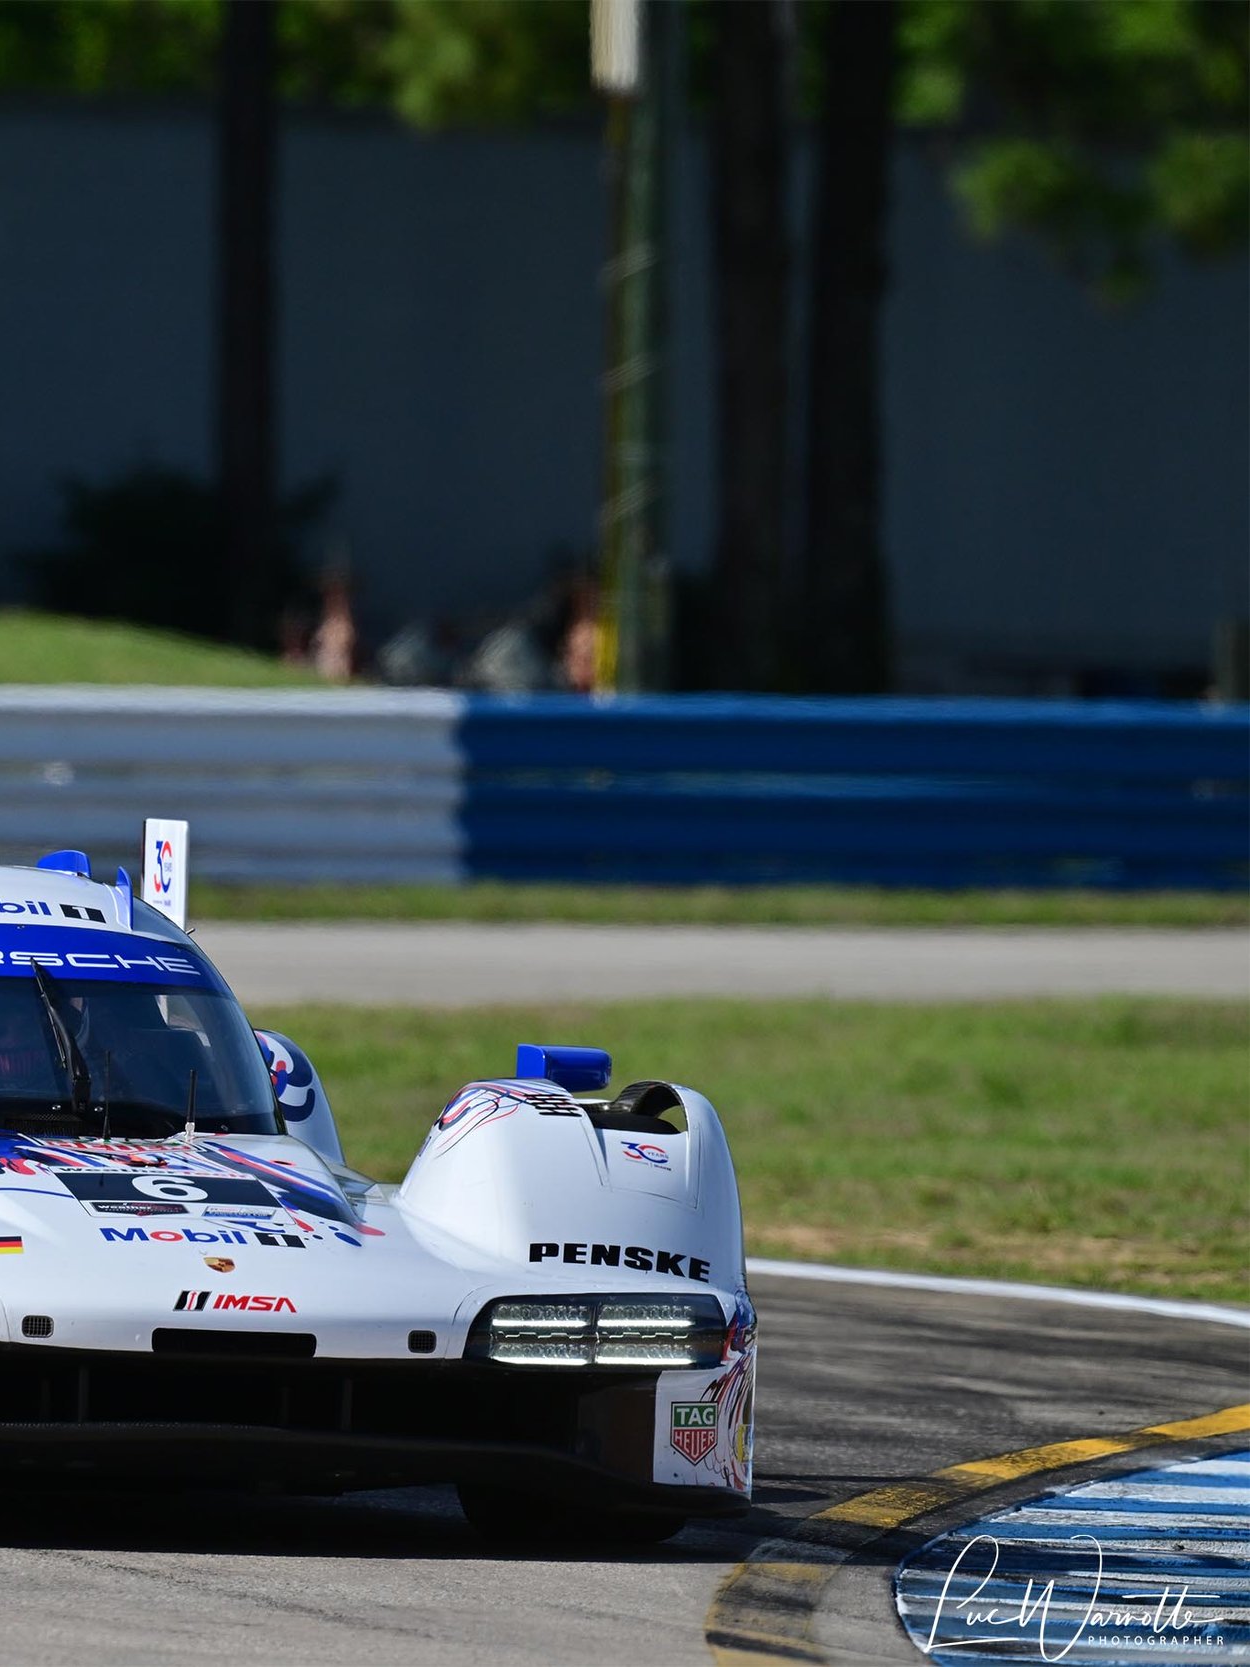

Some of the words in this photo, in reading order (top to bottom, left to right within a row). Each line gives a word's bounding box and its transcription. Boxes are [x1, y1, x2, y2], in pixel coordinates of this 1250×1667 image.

[132, 1175, 209, 1200] 6
[99, 1227, 248, 1245] Mobil
[529, 1243, 711, 1283] PENSKE
[212, 1294, 297, 1313] IMSA
[676, 1408, 714, 1425] TAG
[674, 1431, 715, 1459] HEUER
